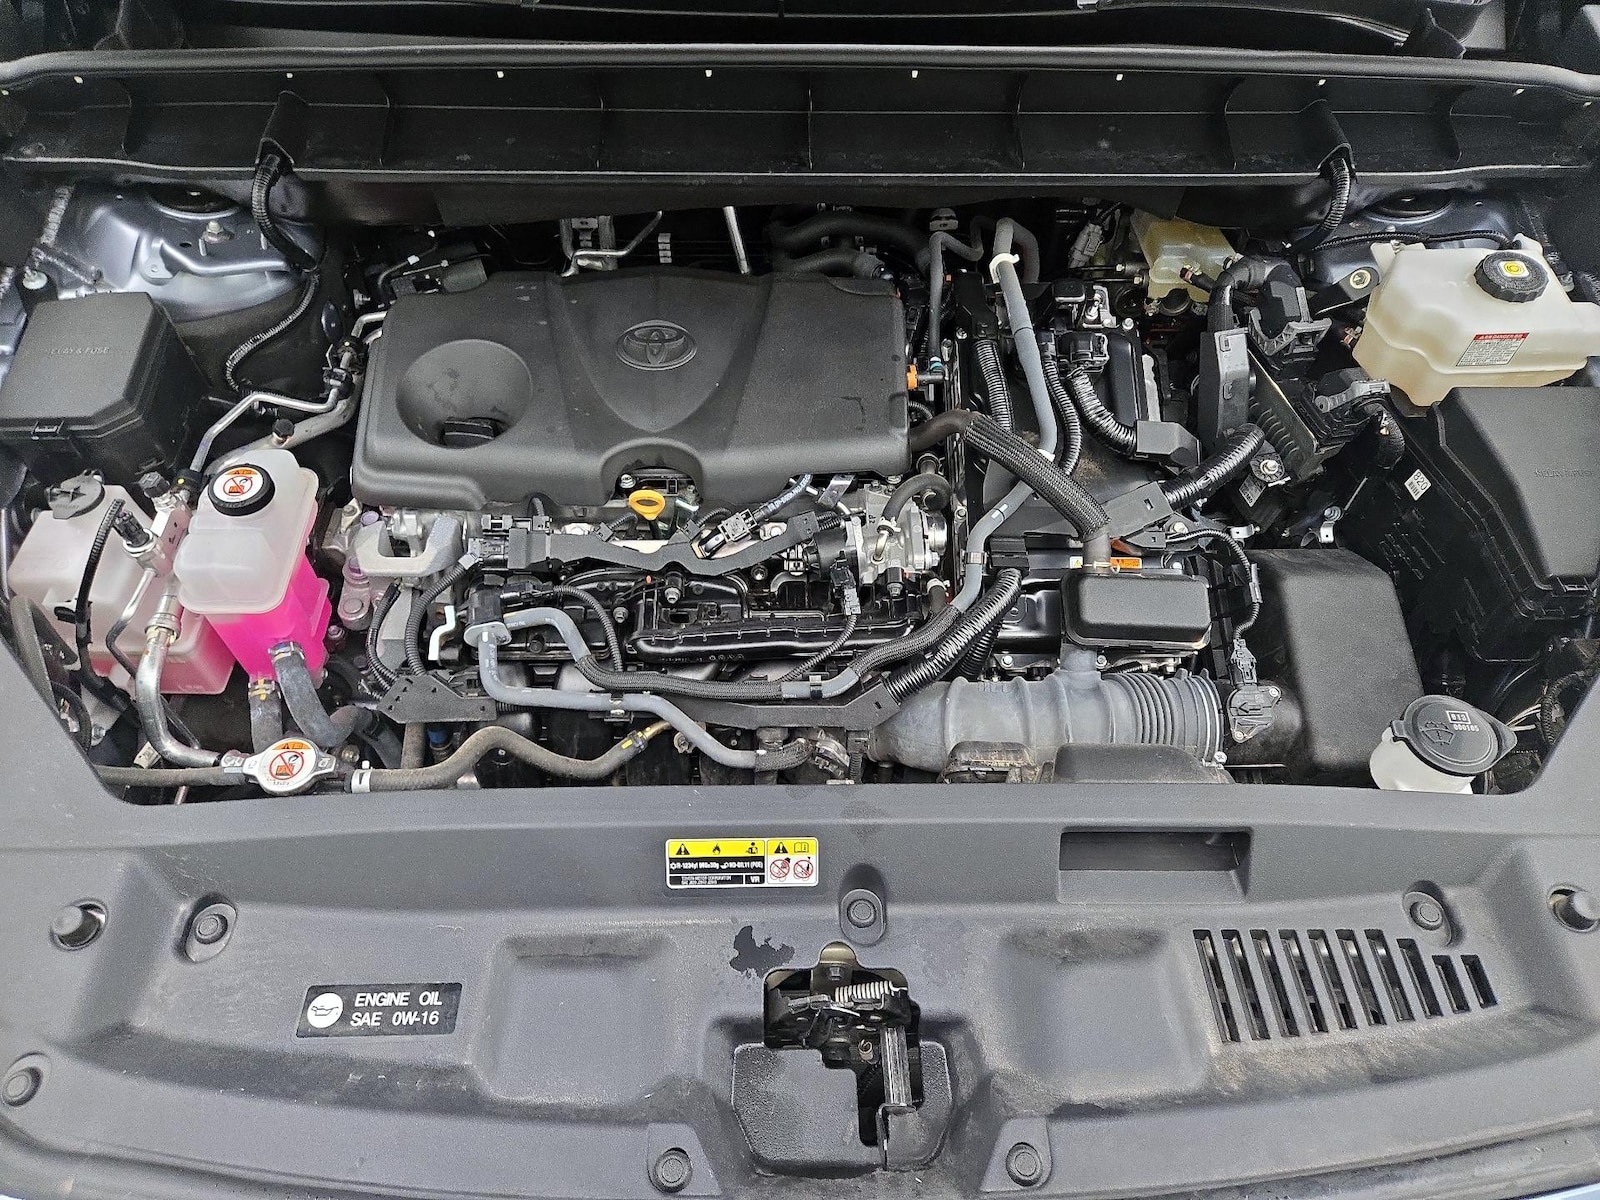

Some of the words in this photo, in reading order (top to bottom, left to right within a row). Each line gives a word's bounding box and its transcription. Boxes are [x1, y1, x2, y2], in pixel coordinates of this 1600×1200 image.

[1413, 471, 1429, 490] 820
[354, 992, 410, 1006] ENGINE
[418, 991, 443, 1006] OIL
[350, 1012, 382, 1026] SAE
[391, 1010, 440, 1026] 0W-16
